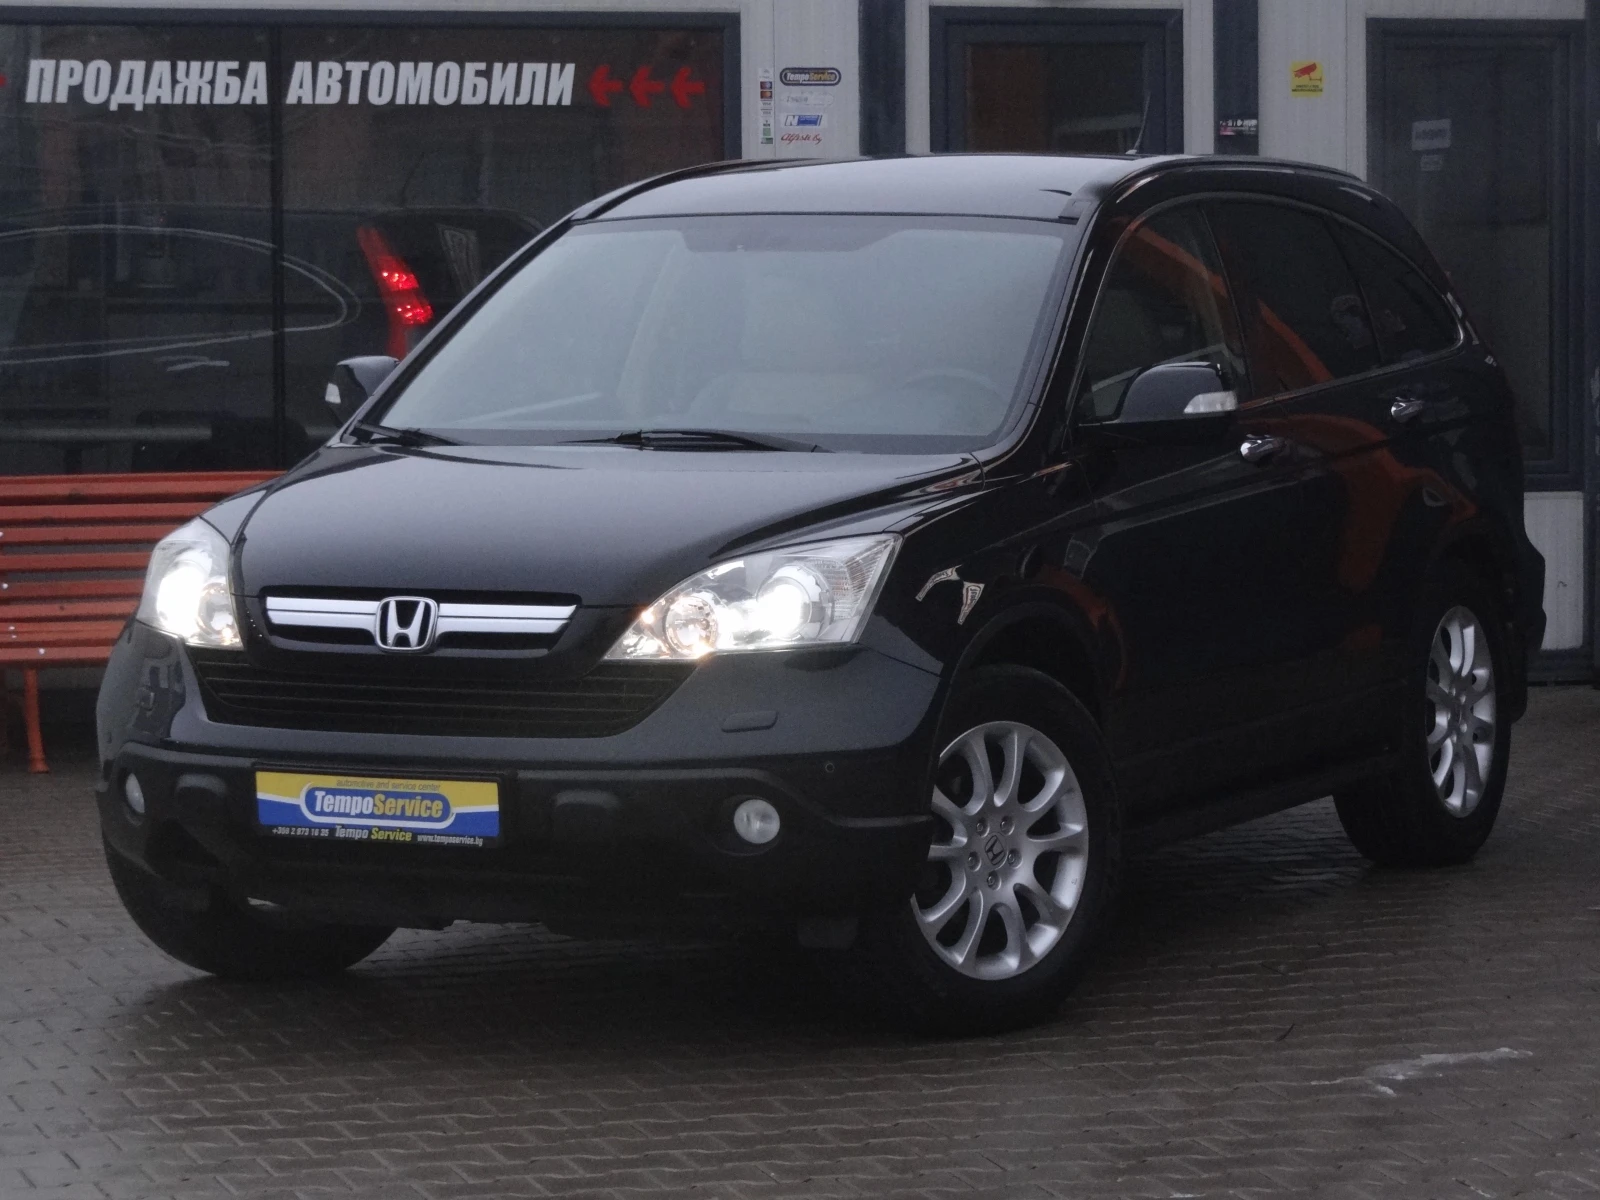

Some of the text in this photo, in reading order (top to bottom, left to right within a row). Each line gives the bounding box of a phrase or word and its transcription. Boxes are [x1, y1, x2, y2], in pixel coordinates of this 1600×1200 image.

[25, 59, 576, 111] ПРОДАЖБА АВТОМОБИЛИ
[336, 779, 441, 792] automotive and service center
[314, 790, 444, 818] TempoService
[335, 825, 369, 840] Tempo
[371, 827, 412, 842] Service
